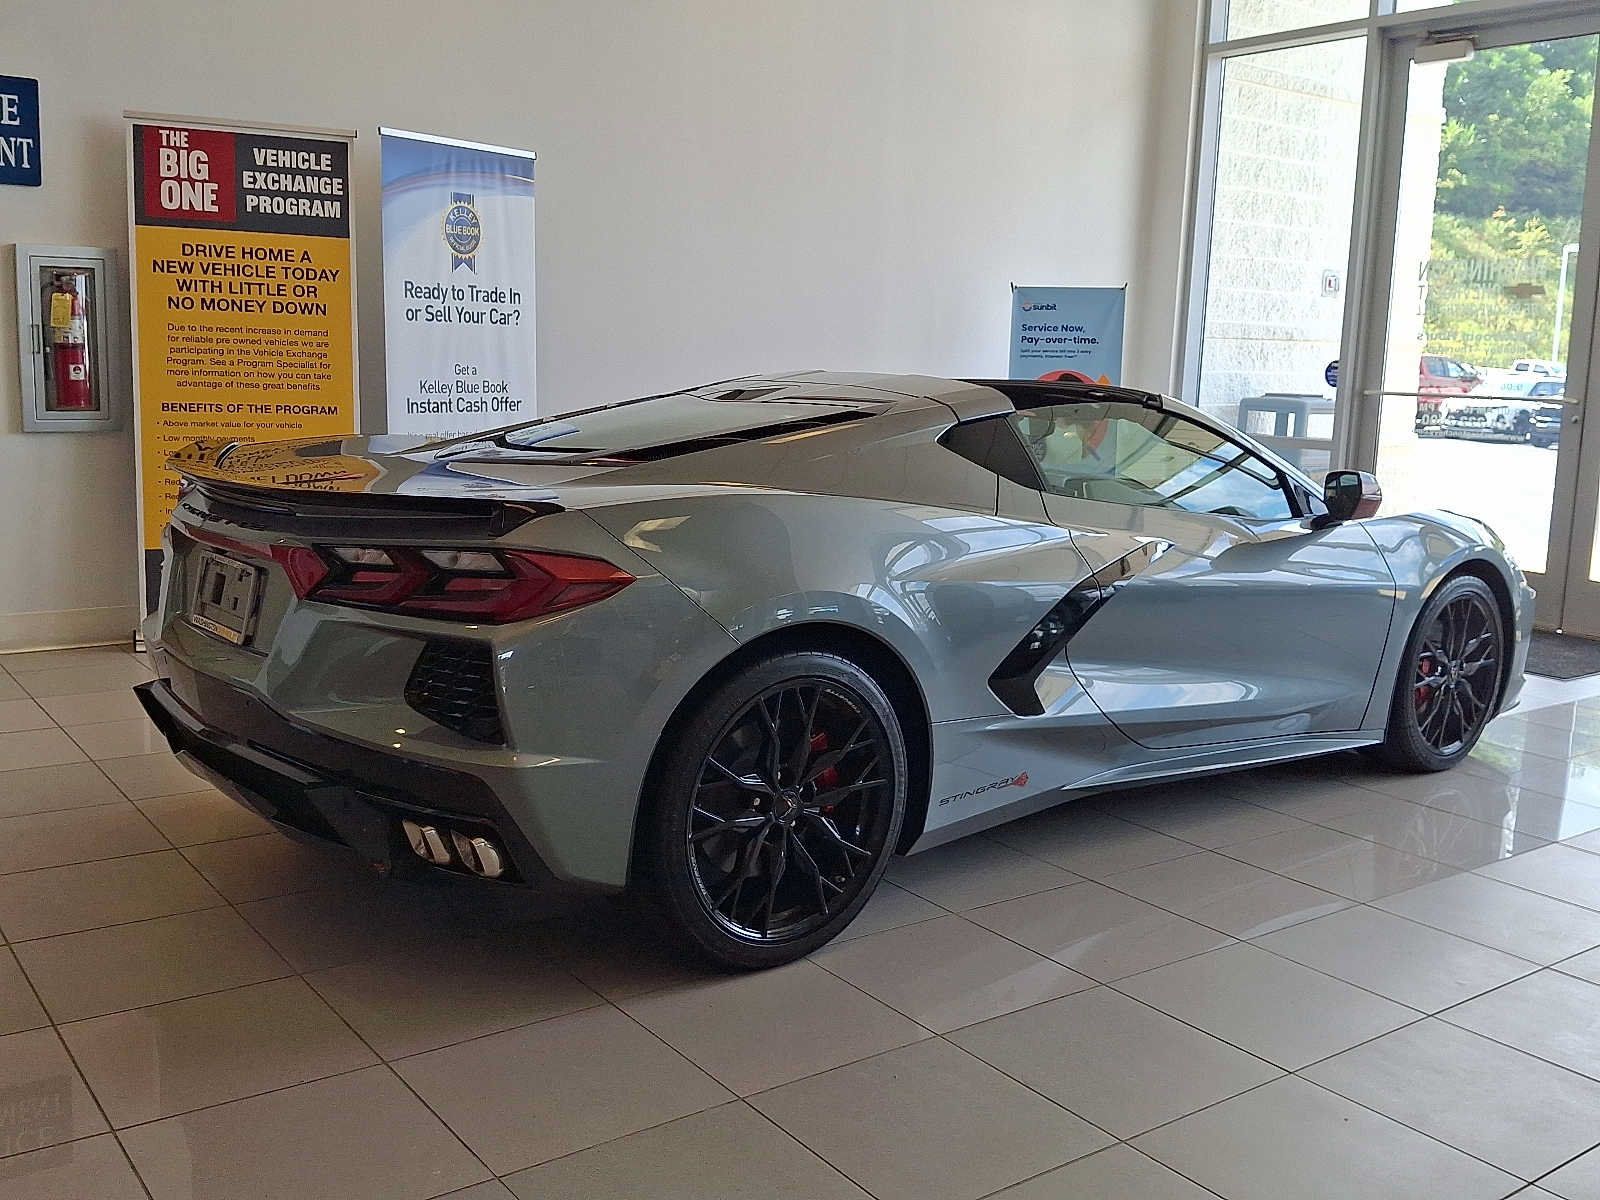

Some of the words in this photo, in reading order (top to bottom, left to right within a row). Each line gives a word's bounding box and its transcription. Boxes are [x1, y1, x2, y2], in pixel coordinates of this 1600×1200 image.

[159, 130, 189, 147] THE
[159, 148, 209, 180] BIG
[253, 148, 332, 171] VEHICLE
[242, 171, 343, 195] EXCHANGE
[160, 180, 218, 212] ONE
[246, 195, 341, 218] PROGRAM
[449, 209, 478, 223] KELLEY
[446, 224, 461, 235] BLUE
[463, 226, 480, 236] BOOK
[182, 243, 235, 258] DRIVE
[242, 247, 295, 262] HOME
[300, 251, 312, 263] A
[152, 260, 194, 274] NEW
[200, 263, 276, 279] VEHICLE
[282, 267, 340, 282] TODAY
[177, 279, 222, 294] WITH
[229, 281, 286, 297] LITTLE
[293, 285, 318, 298] OR
[404, 281, 448, 304] Ready
[452, 285, 465, 301] to
[468, 285, 506, 304] Trade
[510, 288, 520, 304] In
[168, 296, 194, 310] NO
[201, 298, 266, 313] MONEY
[272, 301, 327, 316] DOWN
[406, 308, 421, 321] or
[425, 305, 452, 322] Sell
[456, 306, 486, 324] Your
[490, 308, 520, 325] Car?
[167, 323, 185, 331] Due
[188, 324, 196, 332] to
[216, 326, 243, 334] recent
[246, 326, 281, 335] increase
[294, 328, 328, 337] demand
[1022, 324, 1058, 332] Service
[1061, 325, 1085, 333] Now,
[167, 335, 179, 343] for
[182, 335, 213, 343] reliable
[216, 337, 230, 345] pre
[233, 337, 262, 346] owned
[265, 338, 298, 347] vehicles
[1021, 335, 1099, 346] Pay-over-time.
[169, 346, 224, 356] participating
[253, 349, 283, 357] Vehicle
[287, 350, 328, 359] Exchange
[210, 358, 226, 366] See
[237, 359, 274, 369] Program
[277, 361, 317, 370] Specialist
[320, 361, 330, 369] for
[455, 364, 469, 375] Get
[472, 366, 477, 375] a
[192, 369, 241, 377] information
[257, 370, 275, 379] how
[278, 372, 293, 380] you
[314, 372, 331, 380] take
[176, 379, 222, 389] advantage
[236, 381, 260, 389] these
[263, 382, 284, 390] great
[420, 380, 453, 397] Kelley
[456, 380, 479, 393] Blue
[483, 380, 509, 393] Book
[161, 402, 223, 413] BENEFITS
[227, 403, 243, 413] OF
[249, 404, 271, 414] THE
[275, 405, 338, 415] PROGRAM
[407, 397, 453, 414] Instant
[457, 397, 488, 412] Cash
[492, 396, 522, 412] Offer
[191, 420, 218, 428] market
[275, 421, 302, 429] vehicle
[938, 775, 1018, 807] STINGRAY
